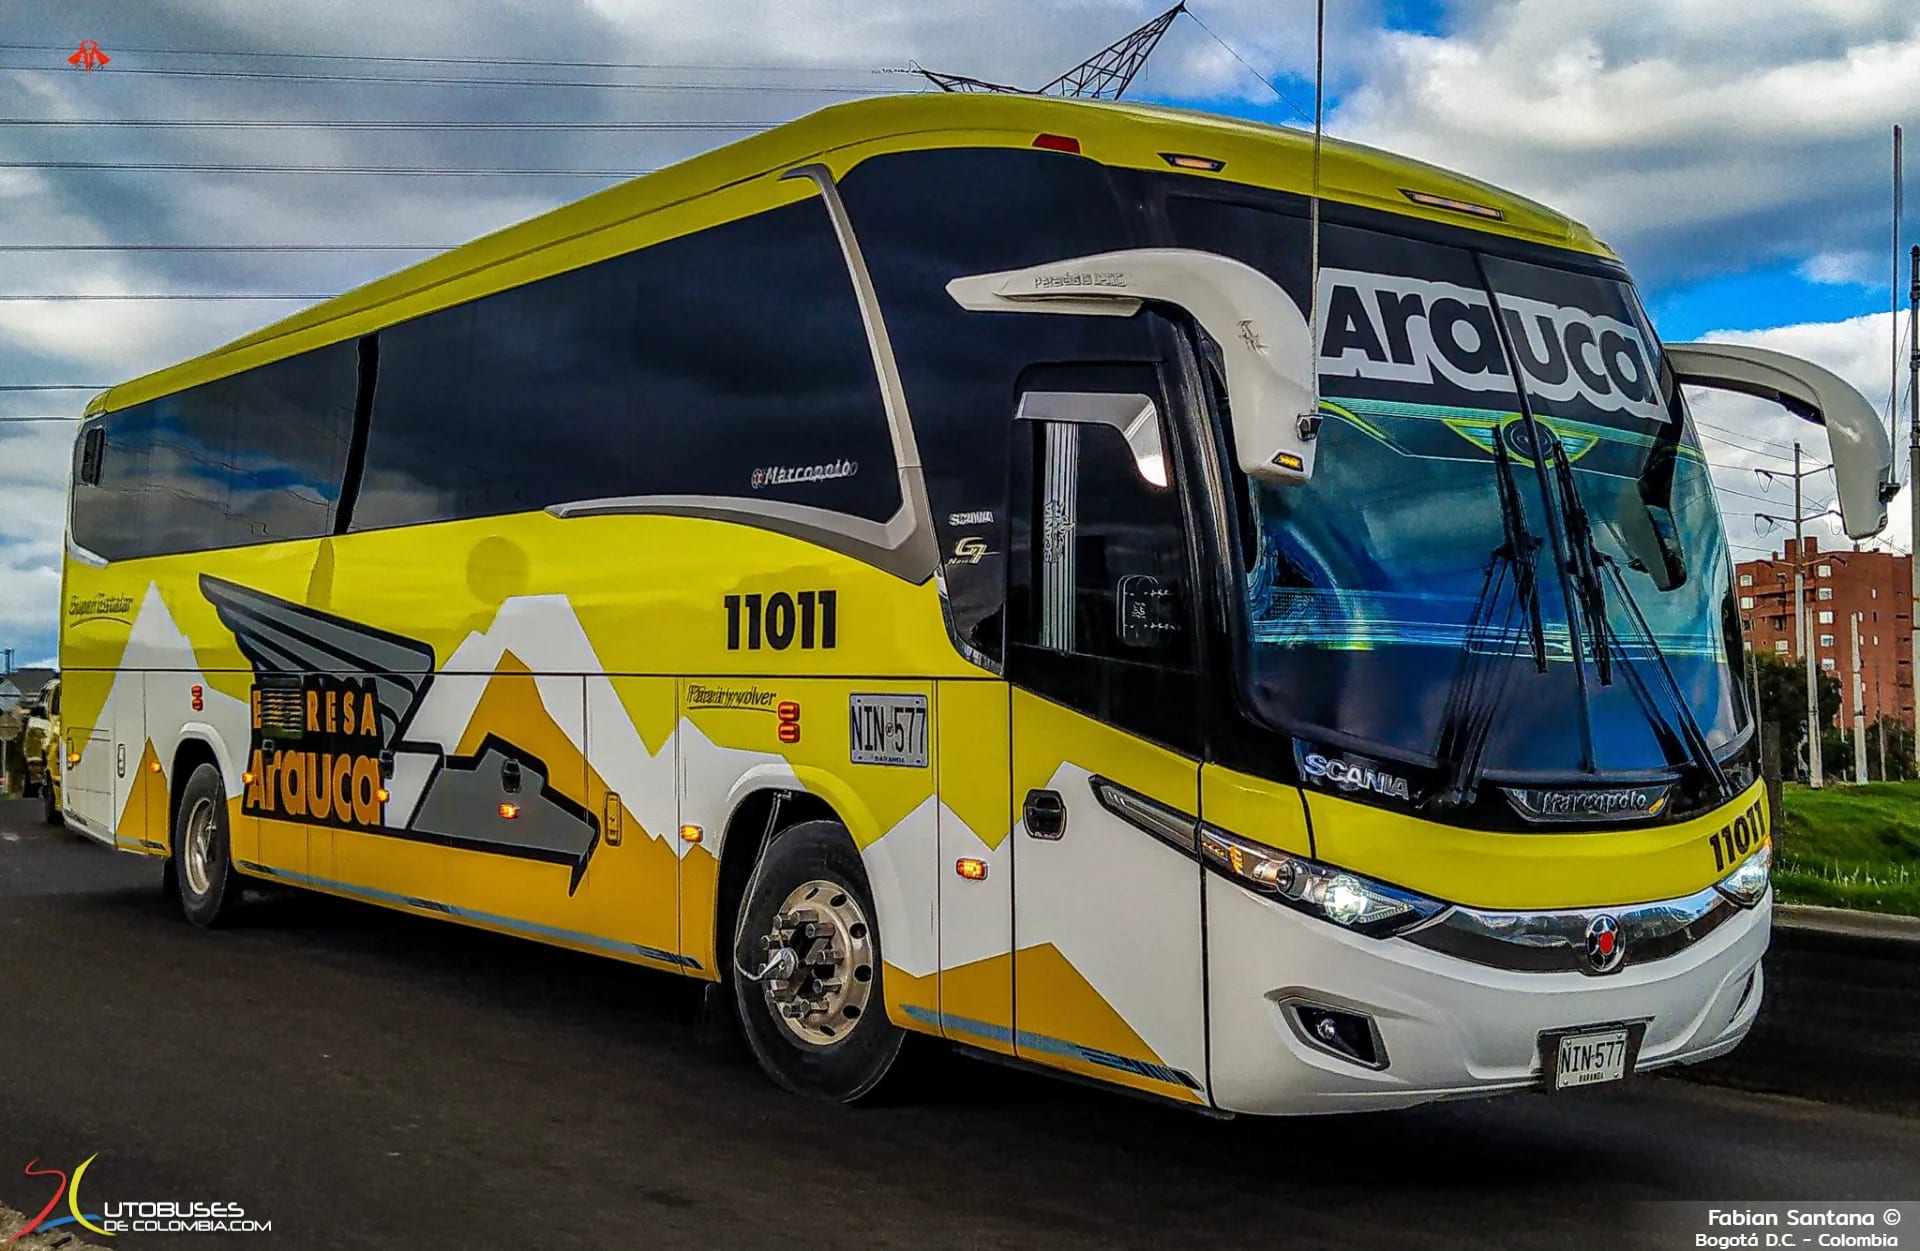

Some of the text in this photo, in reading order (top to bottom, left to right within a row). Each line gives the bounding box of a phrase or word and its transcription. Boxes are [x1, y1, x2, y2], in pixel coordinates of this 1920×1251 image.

[1319, 284, 1659, 406] Arauca
[1042, 502, 1053, 563] SCANIA
[724, 590, 837, 650] 11011
[246, 748, 381, 826] Arauca
[1304, 754, 1410, 801] SCANIA
[1709, 799, 1766, 873] 11011
